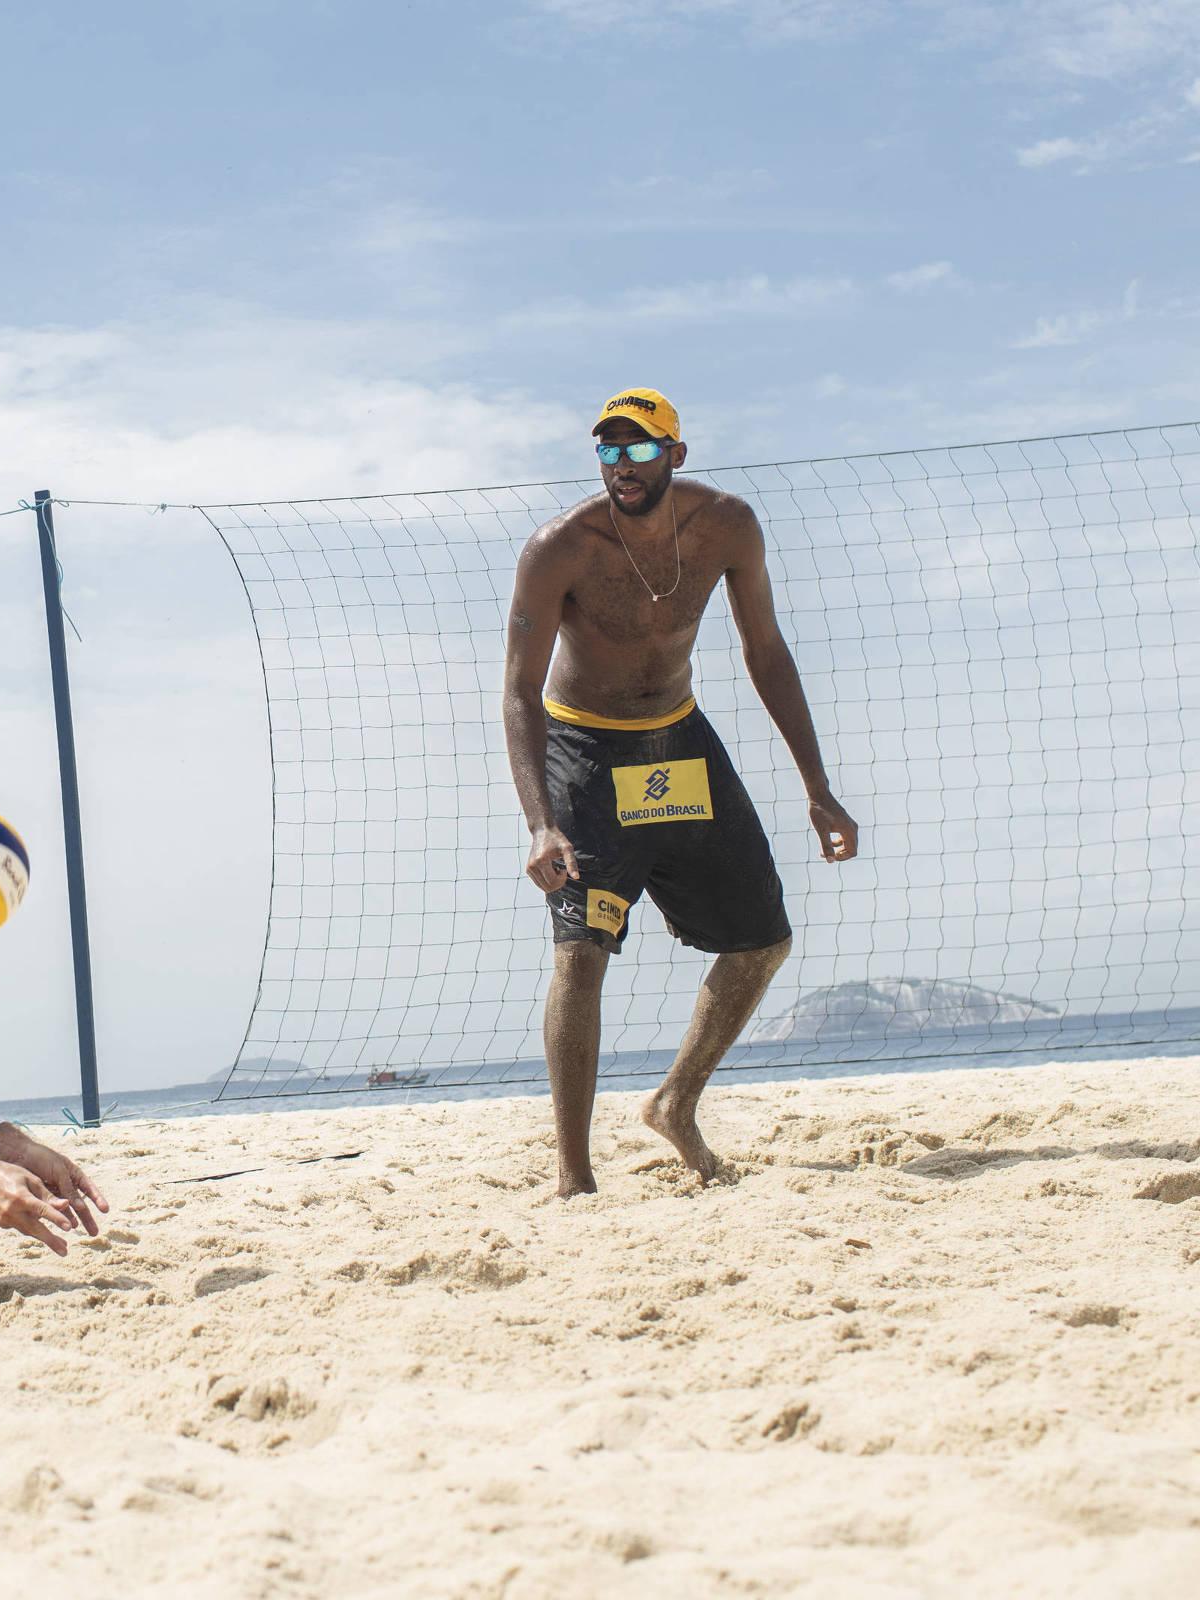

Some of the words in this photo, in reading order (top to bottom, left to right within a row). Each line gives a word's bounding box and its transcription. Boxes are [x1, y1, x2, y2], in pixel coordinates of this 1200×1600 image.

[620, 808, 649, 822] BANCO
[651, 807, 665, 818] DO
[666, 804, 707, 817] BRASIL
[598, 899, 621, 920] CIMED
